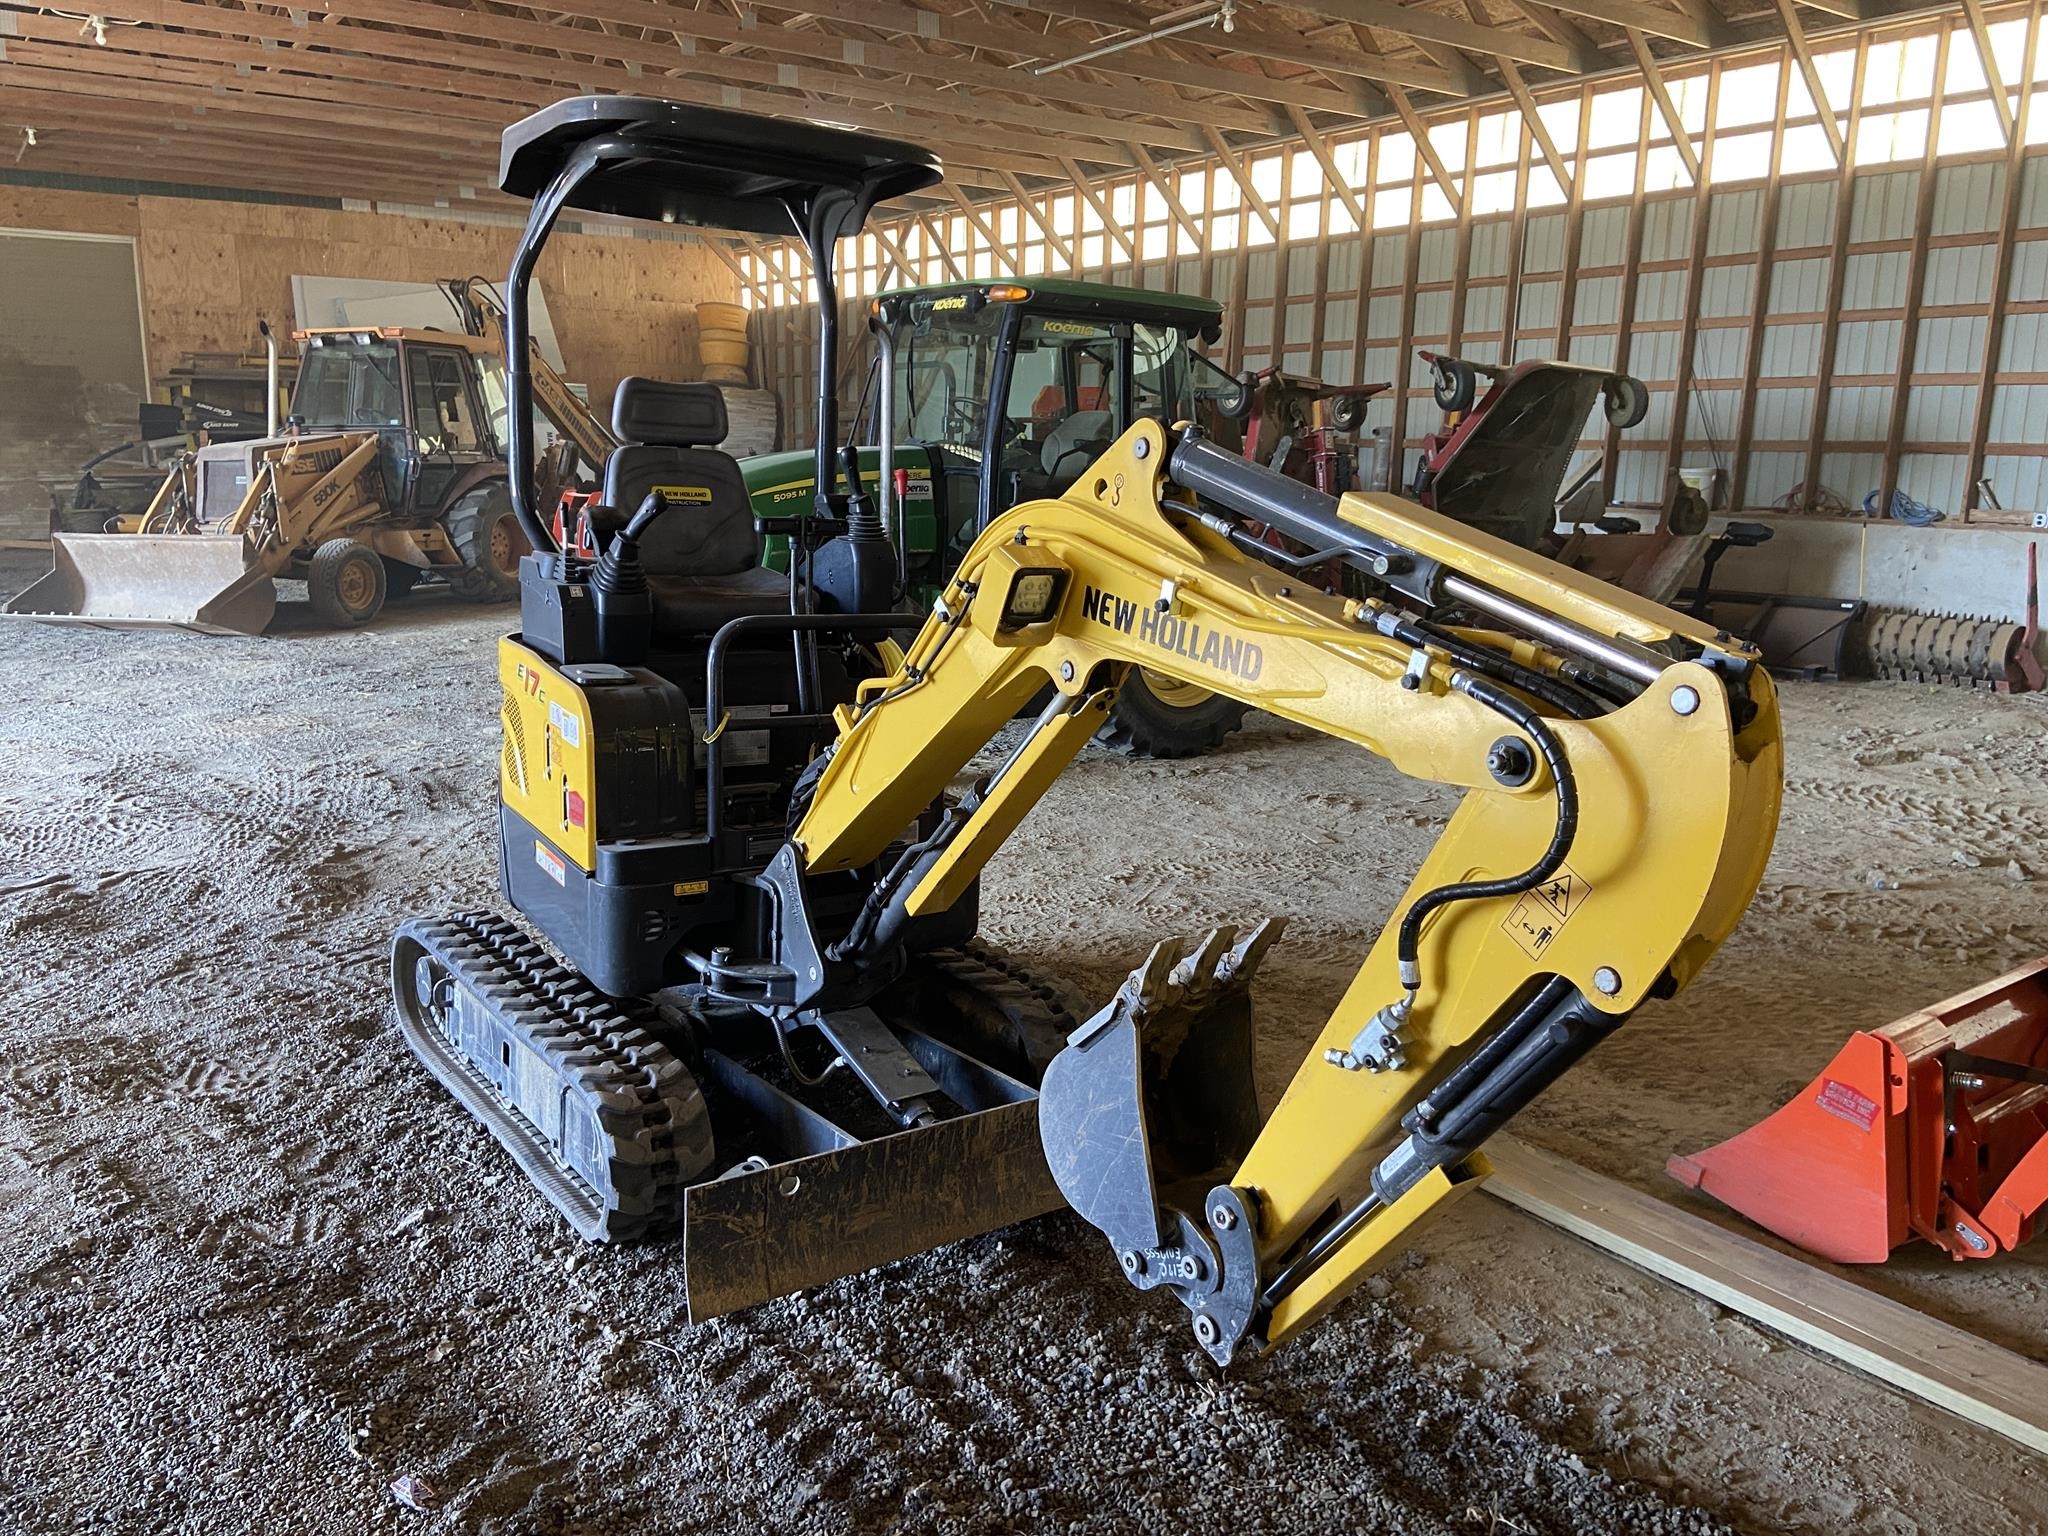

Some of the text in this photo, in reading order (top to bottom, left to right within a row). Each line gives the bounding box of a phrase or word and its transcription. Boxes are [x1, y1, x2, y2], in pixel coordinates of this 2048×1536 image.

[774, 489, 806, 503] 5095 M
[1082, 584, 1264, 682] NEW HOLLAND
